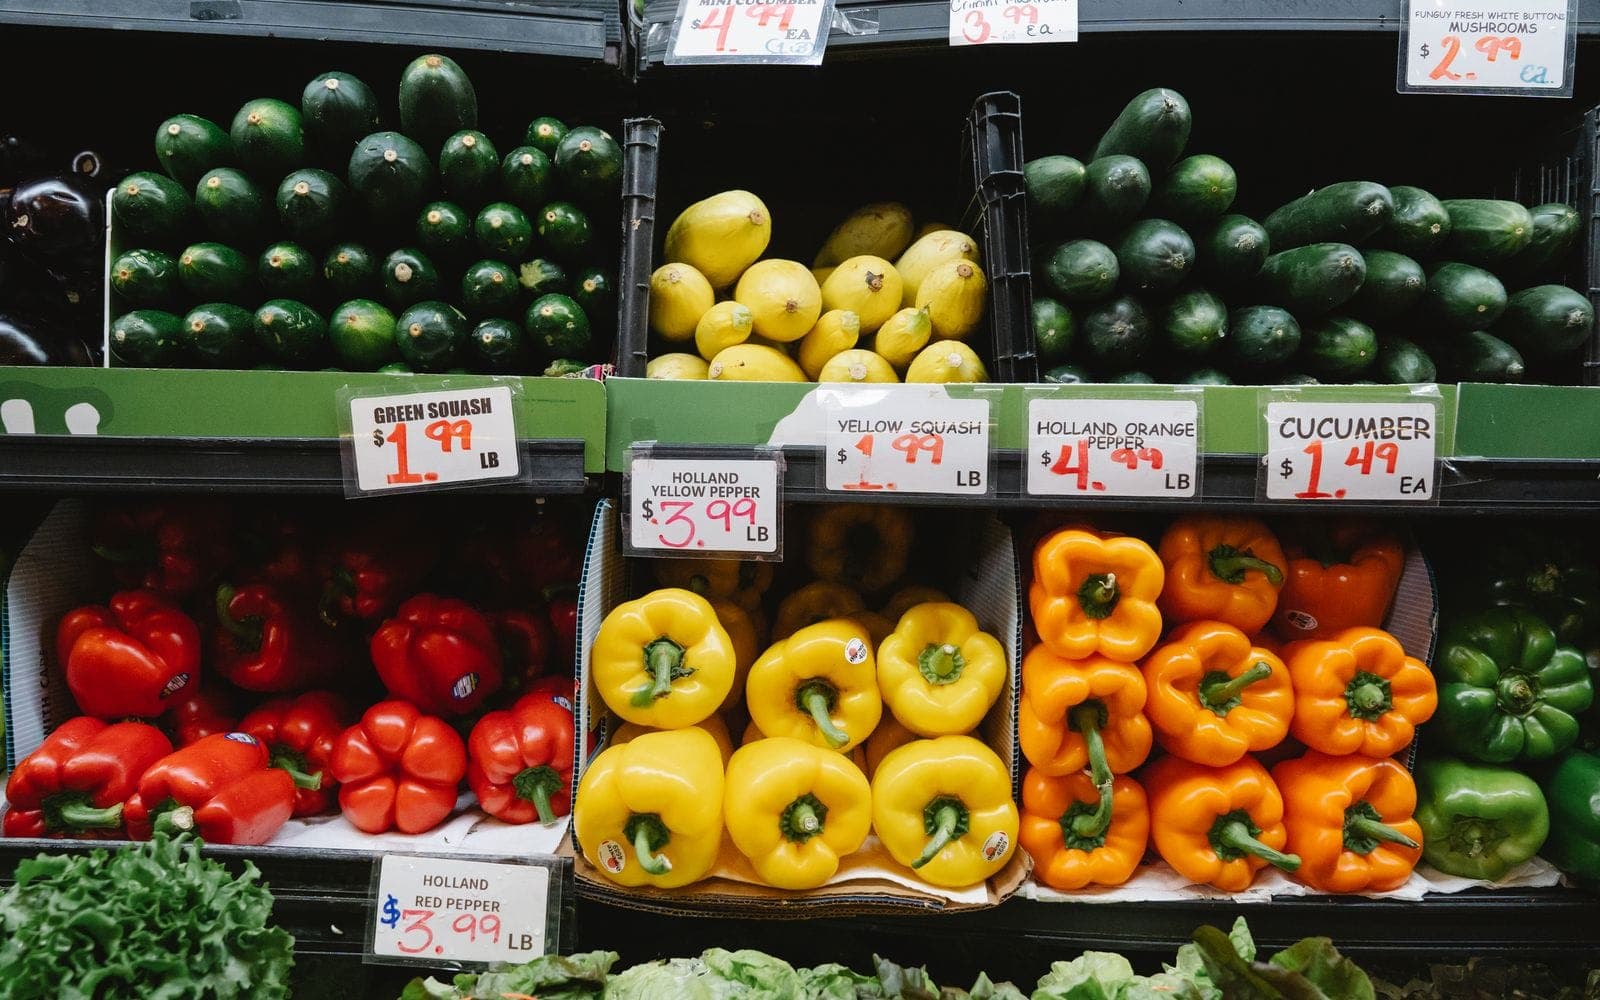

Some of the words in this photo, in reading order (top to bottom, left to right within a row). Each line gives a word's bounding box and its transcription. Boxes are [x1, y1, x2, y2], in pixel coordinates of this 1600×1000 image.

[1415, 10, 1452, 19] FUNGUY
[1455, 11, 1484, 20] FRESH
[1488, 12, 1519, 20] WHITE
[785, 29, 811, 40] EA
[1448, 22, 1538, 34] MUSHROOMS
[374, 404, 425, 424] GREEN
[428, 397, 493, 418] SQUASH
[838, 420, 904, 434] YELLOW
[910, 421, 982, 436] SQUASH
[1037, 421, 1118, 436] HOLLAND
[1124, 422, 1195, 437] ORANGE
[1279, 416, 1431, 440] CUCUMBER
[1088, 436, 1145, 450] PEPPER
[480, 451, 500, 470] LB
[672, 472, 739, 484] HOLLAND
[957, 470, 981, 487] LB
[1165, 474, 1190, 490] LB
[1400, 476, 1426, 494] EA
[652, 486, 706, 498] YELLOW
[710, 486, 760, 498] PEPPER
[746, 526, 769, 542] LB
[423, 875, 489, 891] HOLLAND
[415, 896, 442, 909] RED
[446, 898, 501, 912] PEPPER
[508, 932, 533, 951] LB
